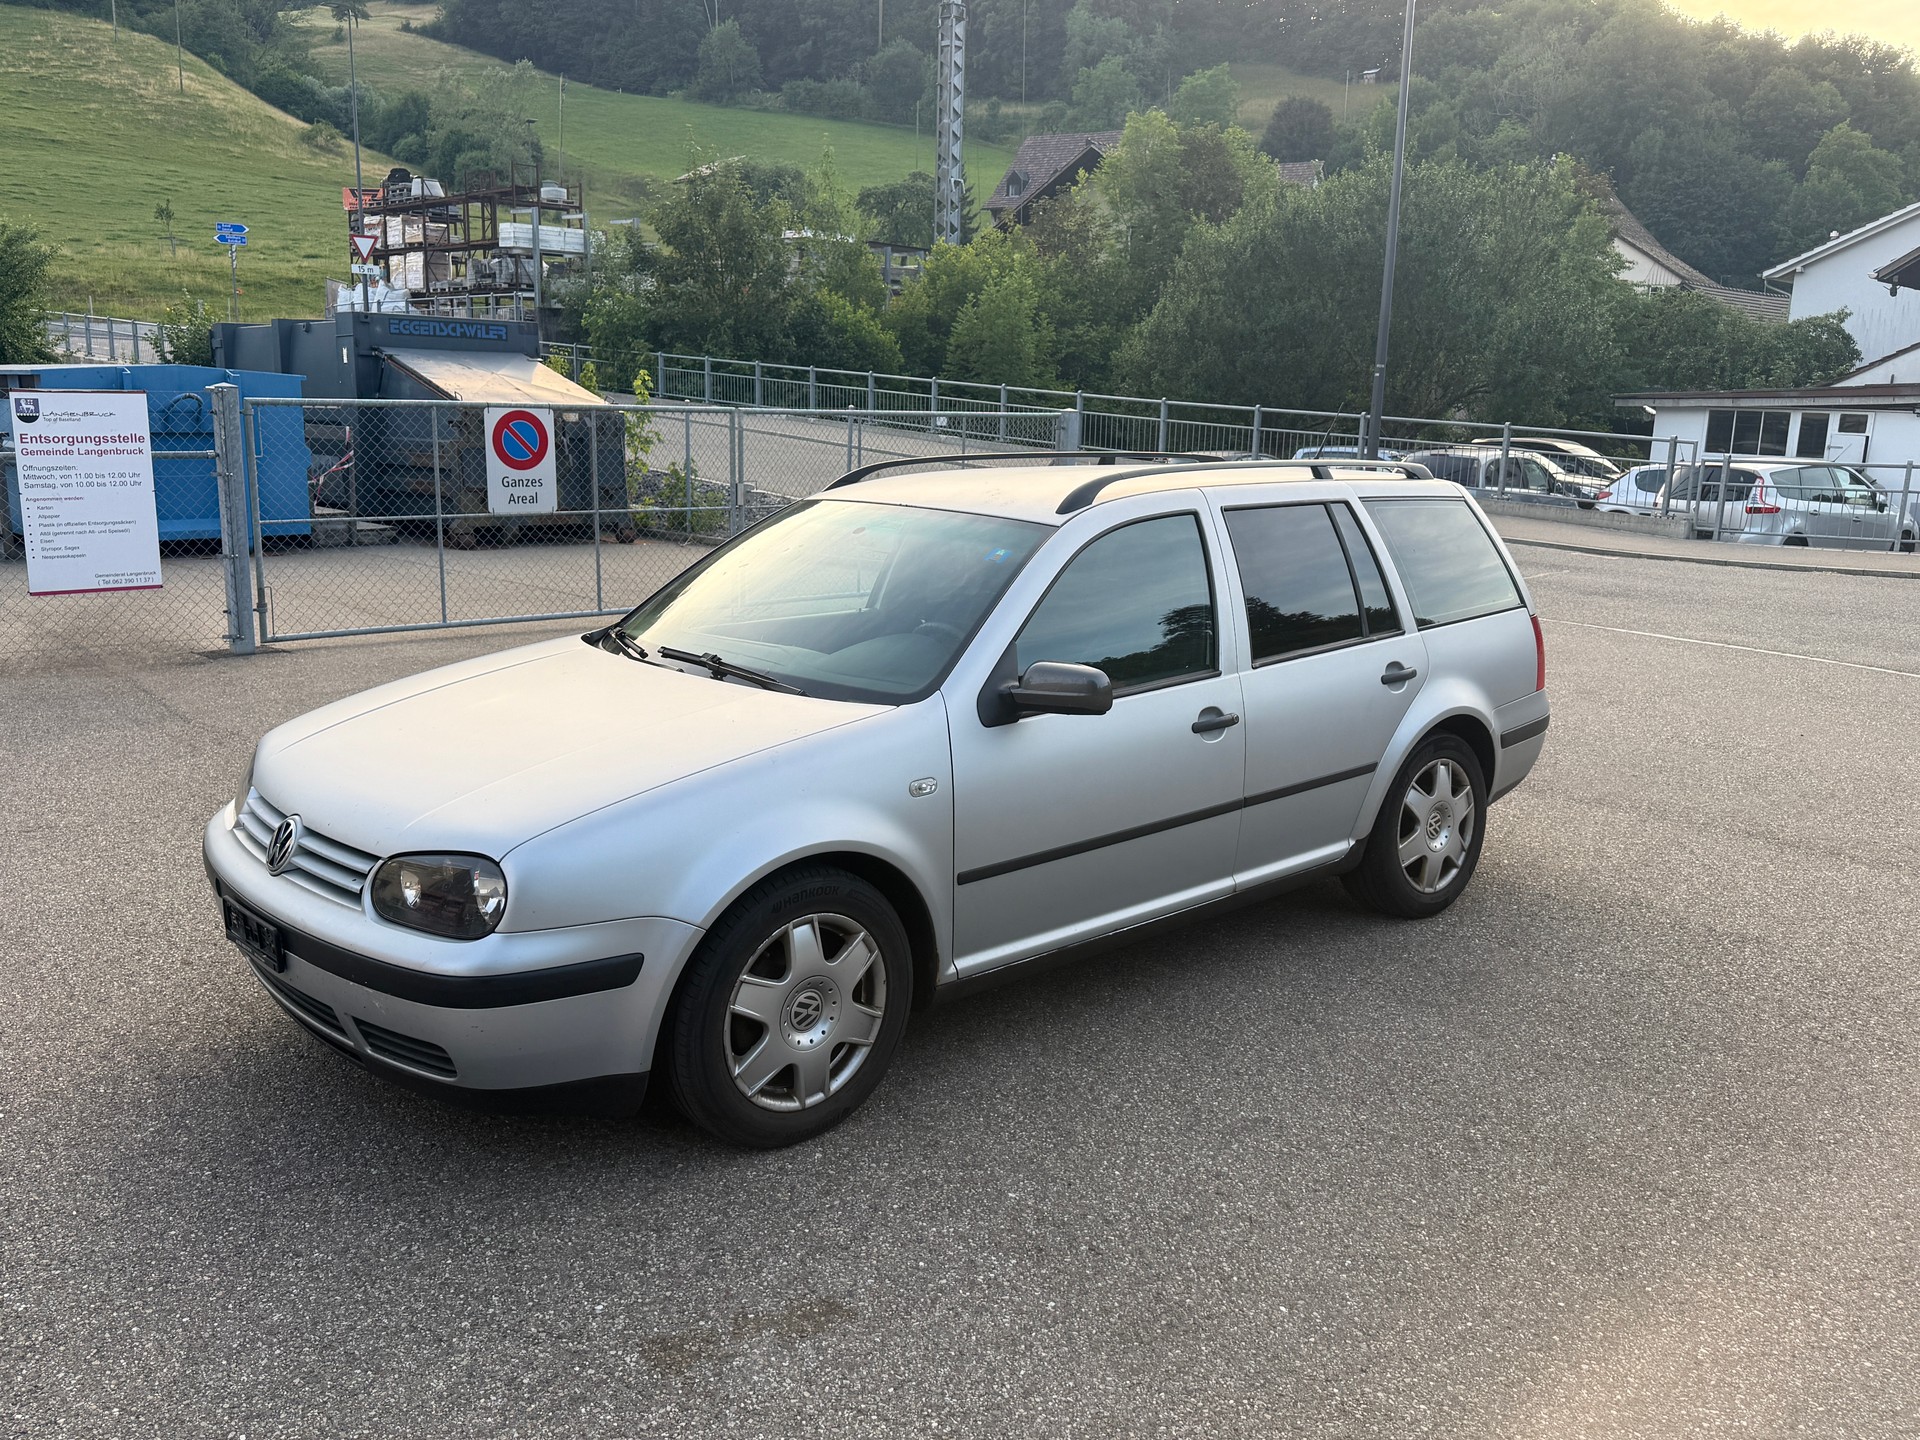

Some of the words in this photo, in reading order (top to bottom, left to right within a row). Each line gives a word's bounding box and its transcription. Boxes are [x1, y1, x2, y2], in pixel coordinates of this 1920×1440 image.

[358, 265, 366, 273] 15
[19, 433, 145, 446] Entsorgungsstelle
[21, 447, 74, 457] Gemeinde
[77, 446, 144, 457] Langenbruck
[22, 464, 78, 472] Öffnungszeiten:
[501, 476, 543, 488] Ganzes
[508, 492, 538, 504] Areal
